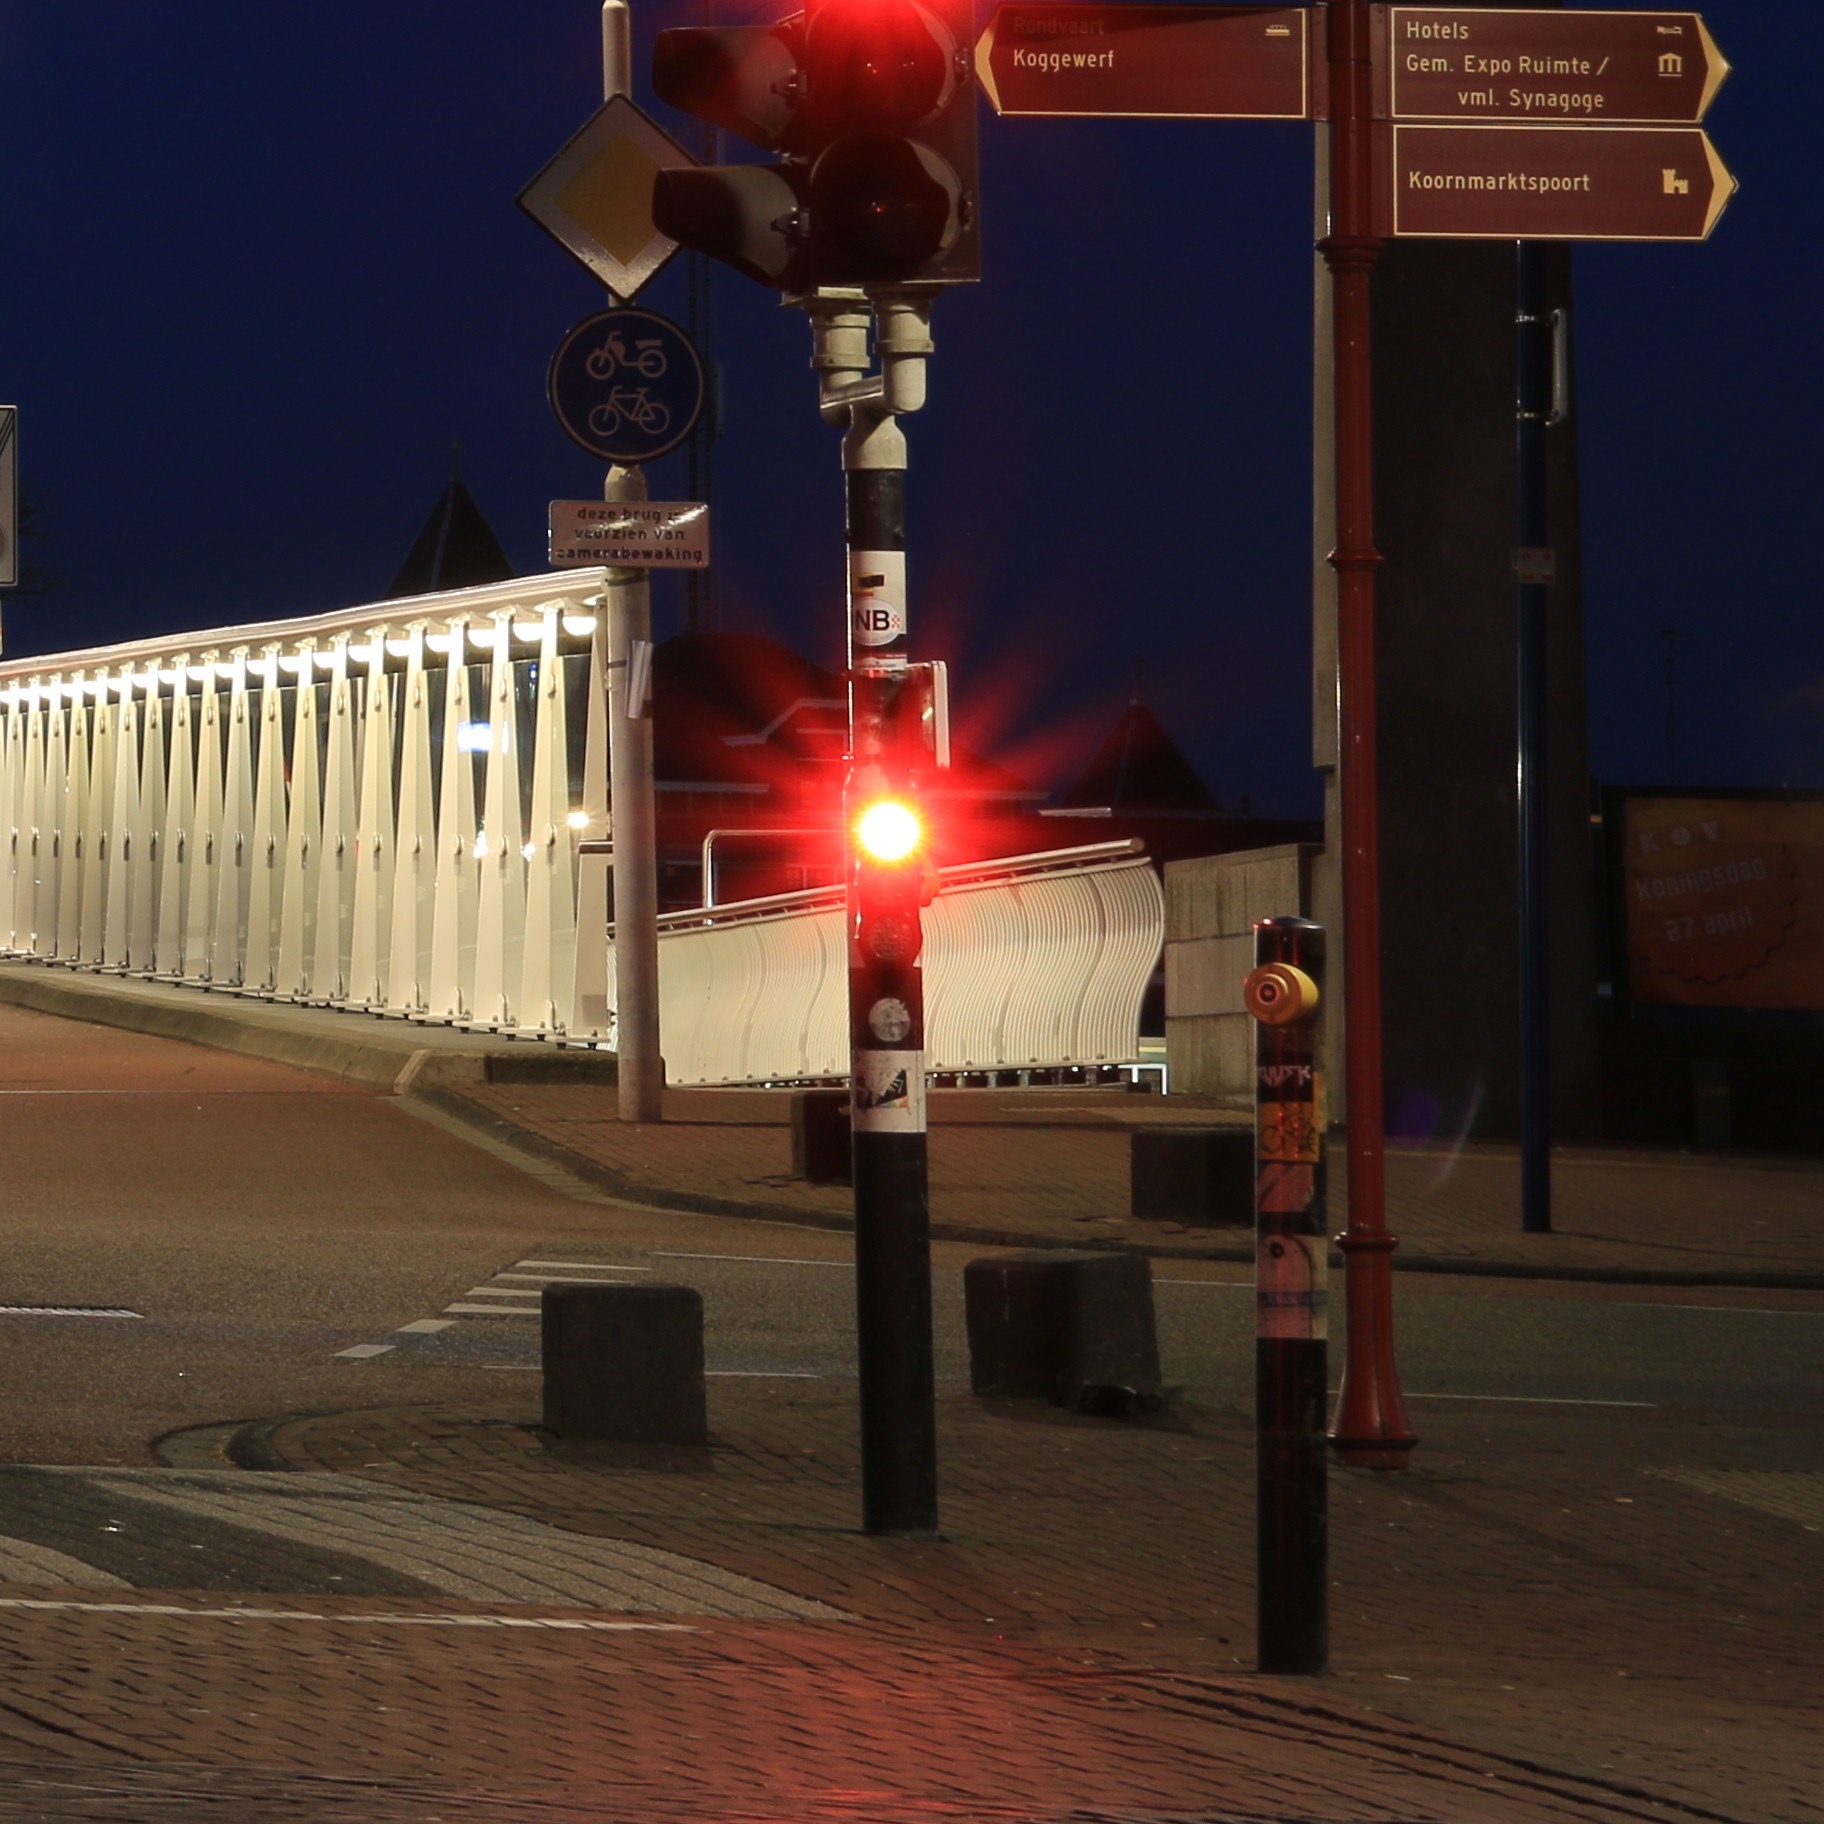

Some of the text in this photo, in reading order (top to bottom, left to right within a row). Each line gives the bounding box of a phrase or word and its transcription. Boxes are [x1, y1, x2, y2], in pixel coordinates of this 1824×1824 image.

[1013, 17, 1105, 35] Rondvaart
[1407, 21, 1469, 39] Hotels
[1013, 49, 1115, 72] Koggewerf
[1406, 54, 1610, 76] Gem. Expo Ruimte /
[1458, 88, 1604, 113] vml. Synagoge
[1409, 171, 1591, 194] Koornmarktspoort
[577, 507, 616, 520] deze
[623, 507, 661, 522] brug
[654, 529, 685, 540] van
[557, 547, 703, 563] camerabewaking
[855, 610, 890, 631] NB
[1634, 858, 1767, 902] Koningsdag
[1663, 904, 1755, 942] 27 april
